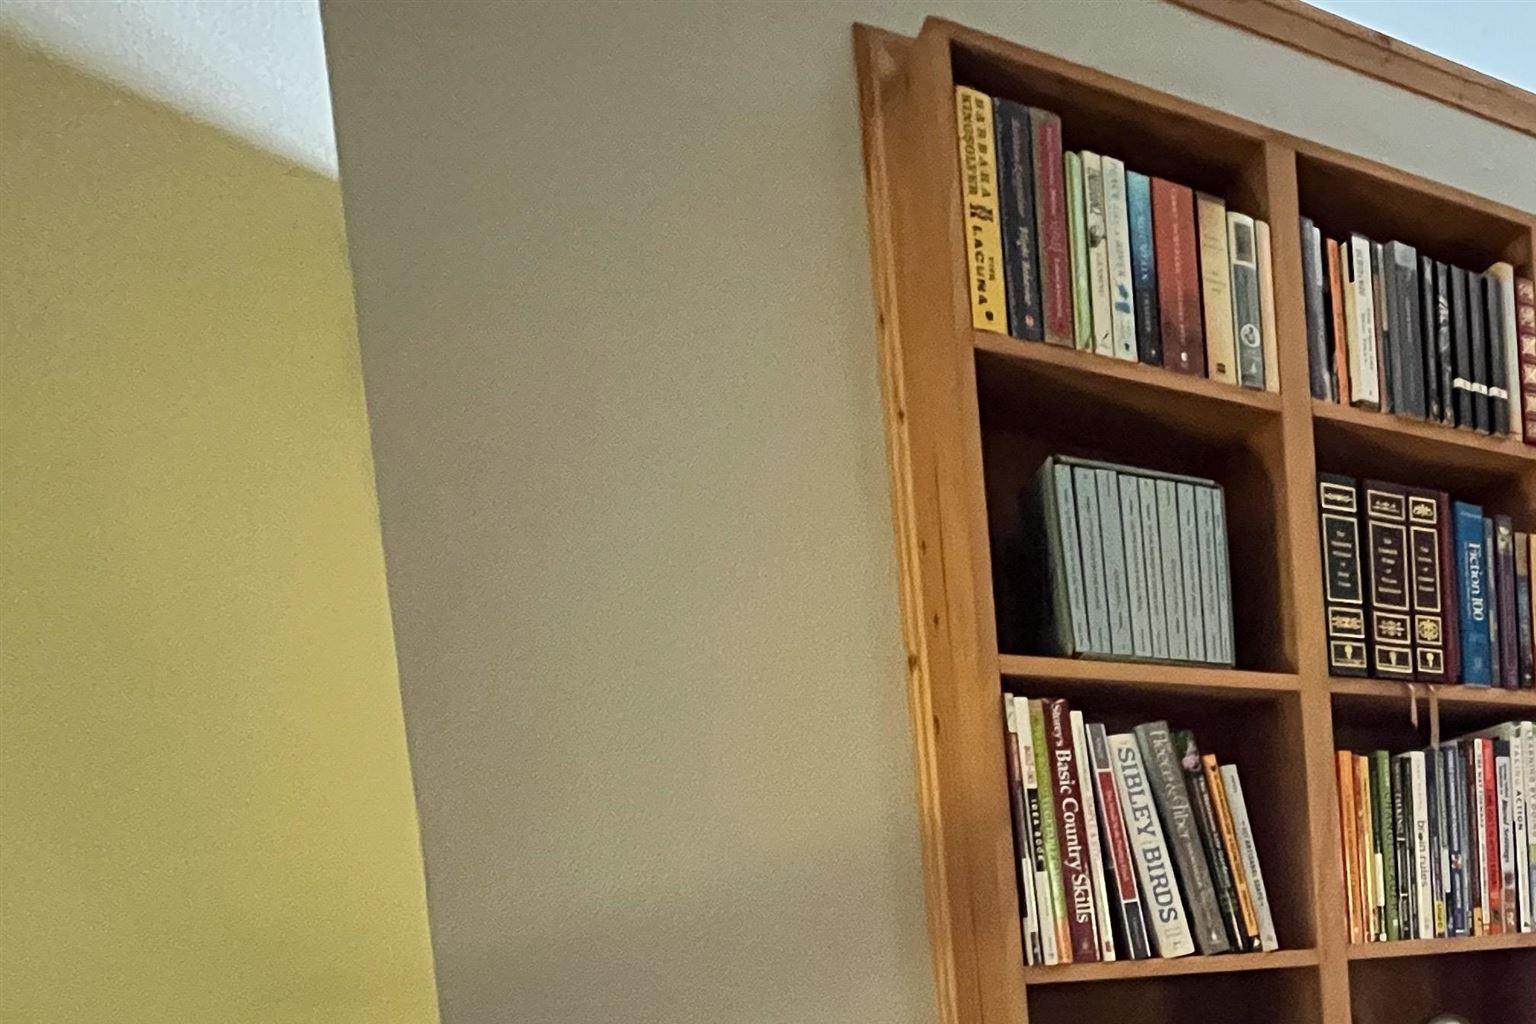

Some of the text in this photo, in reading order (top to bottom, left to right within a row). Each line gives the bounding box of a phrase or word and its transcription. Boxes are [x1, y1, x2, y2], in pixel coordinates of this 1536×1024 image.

[971, 224, 988, 305] LACUNA
[1468, 541, 1485, 622] Fiction 100
[1031, 798, 1044, 861] IDEA BOOK
[1051, 702, 1093, 925] Storey's Basic Country Skills
[1117, 746, 1157, 837] SIBLEY
[1142, 845, 1179, 924] BIRDS
[1420, 855, 1430, 888] rules
